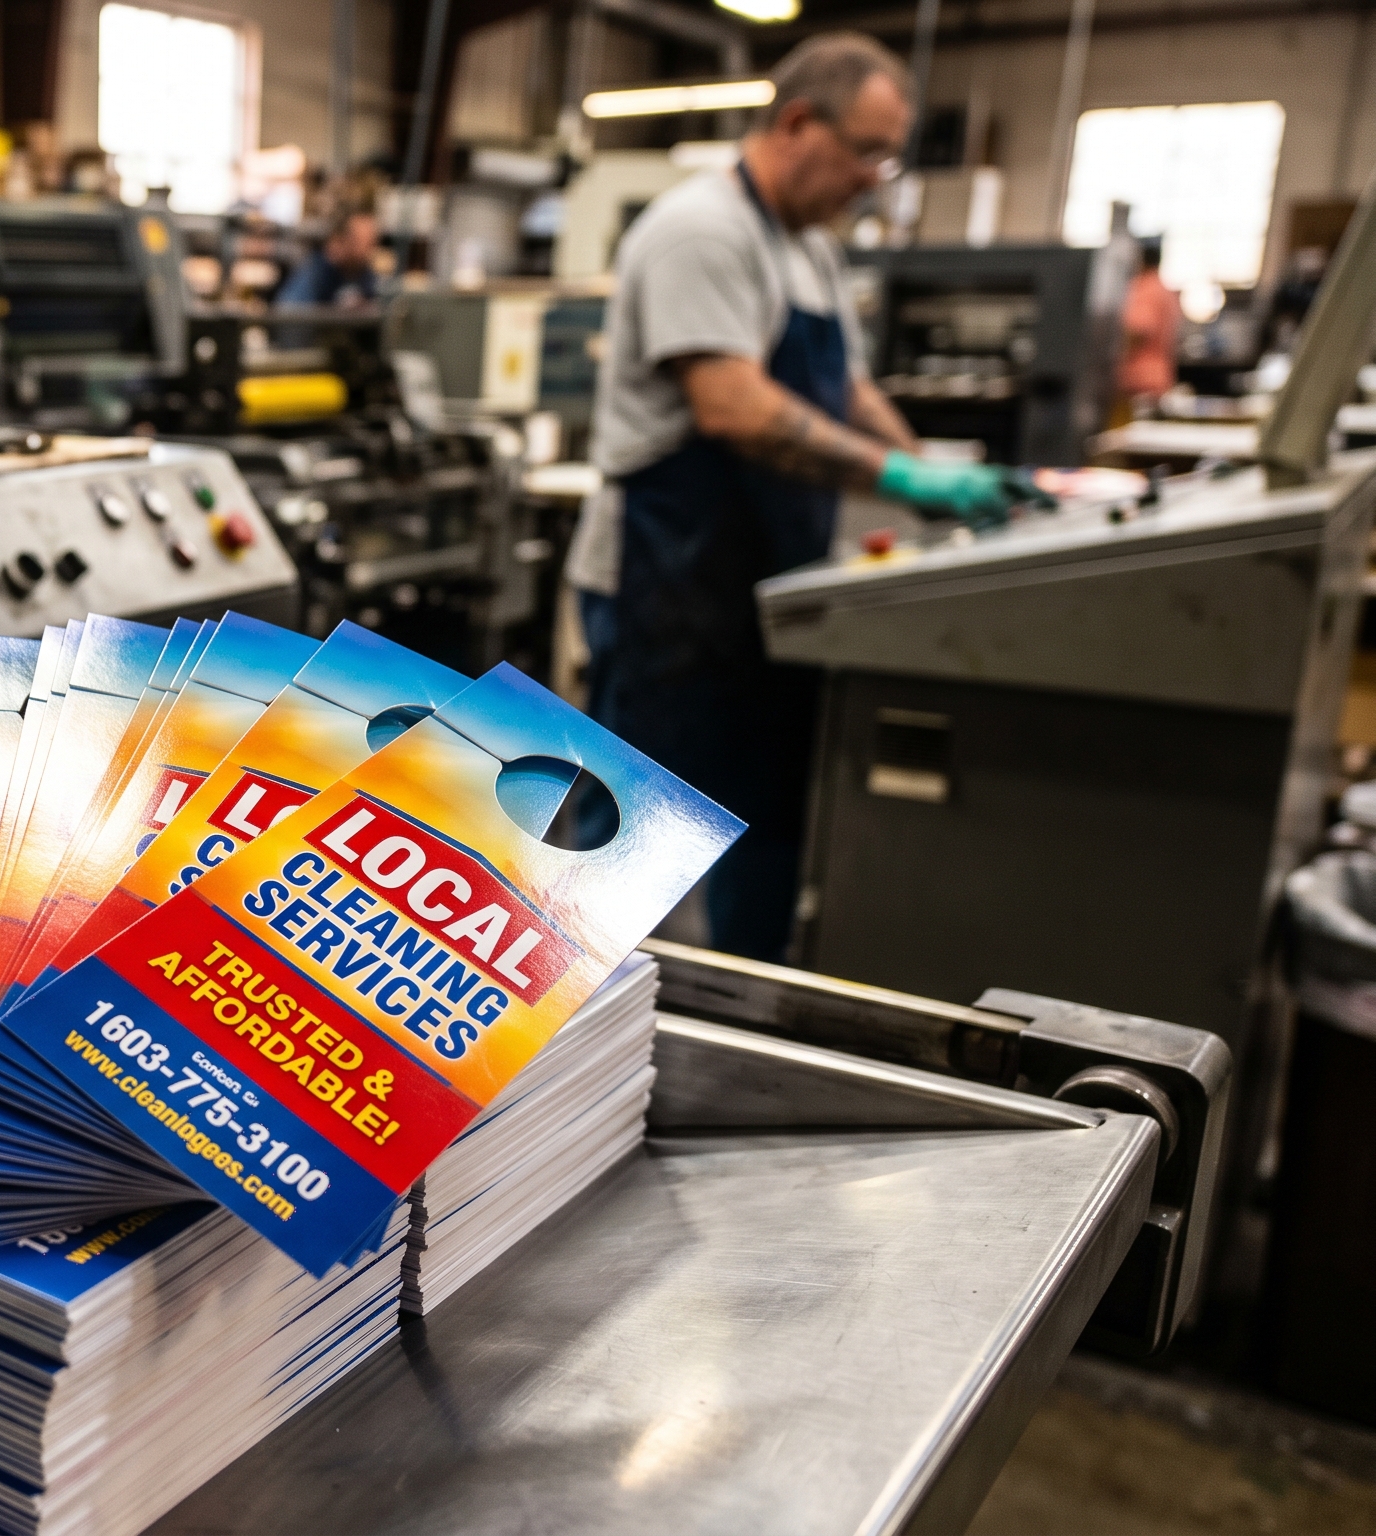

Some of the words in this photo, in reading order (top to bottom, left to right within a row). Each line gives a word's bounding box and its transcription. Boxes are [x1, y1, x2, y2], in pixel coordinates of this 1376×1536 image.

[243, 880, 478, 1060] SERVICES
[282, 852, 509, 1027] CLEANING
[321, 808, 543, 990] LOCAL
[85, 1000, 330, 1201] 1603-775-3100
[147, 951, 401, 1146] AFFORDABLE!
[203, 940, 364, 1071] TRUSTED
[362, 1069, 395, 1102] &
